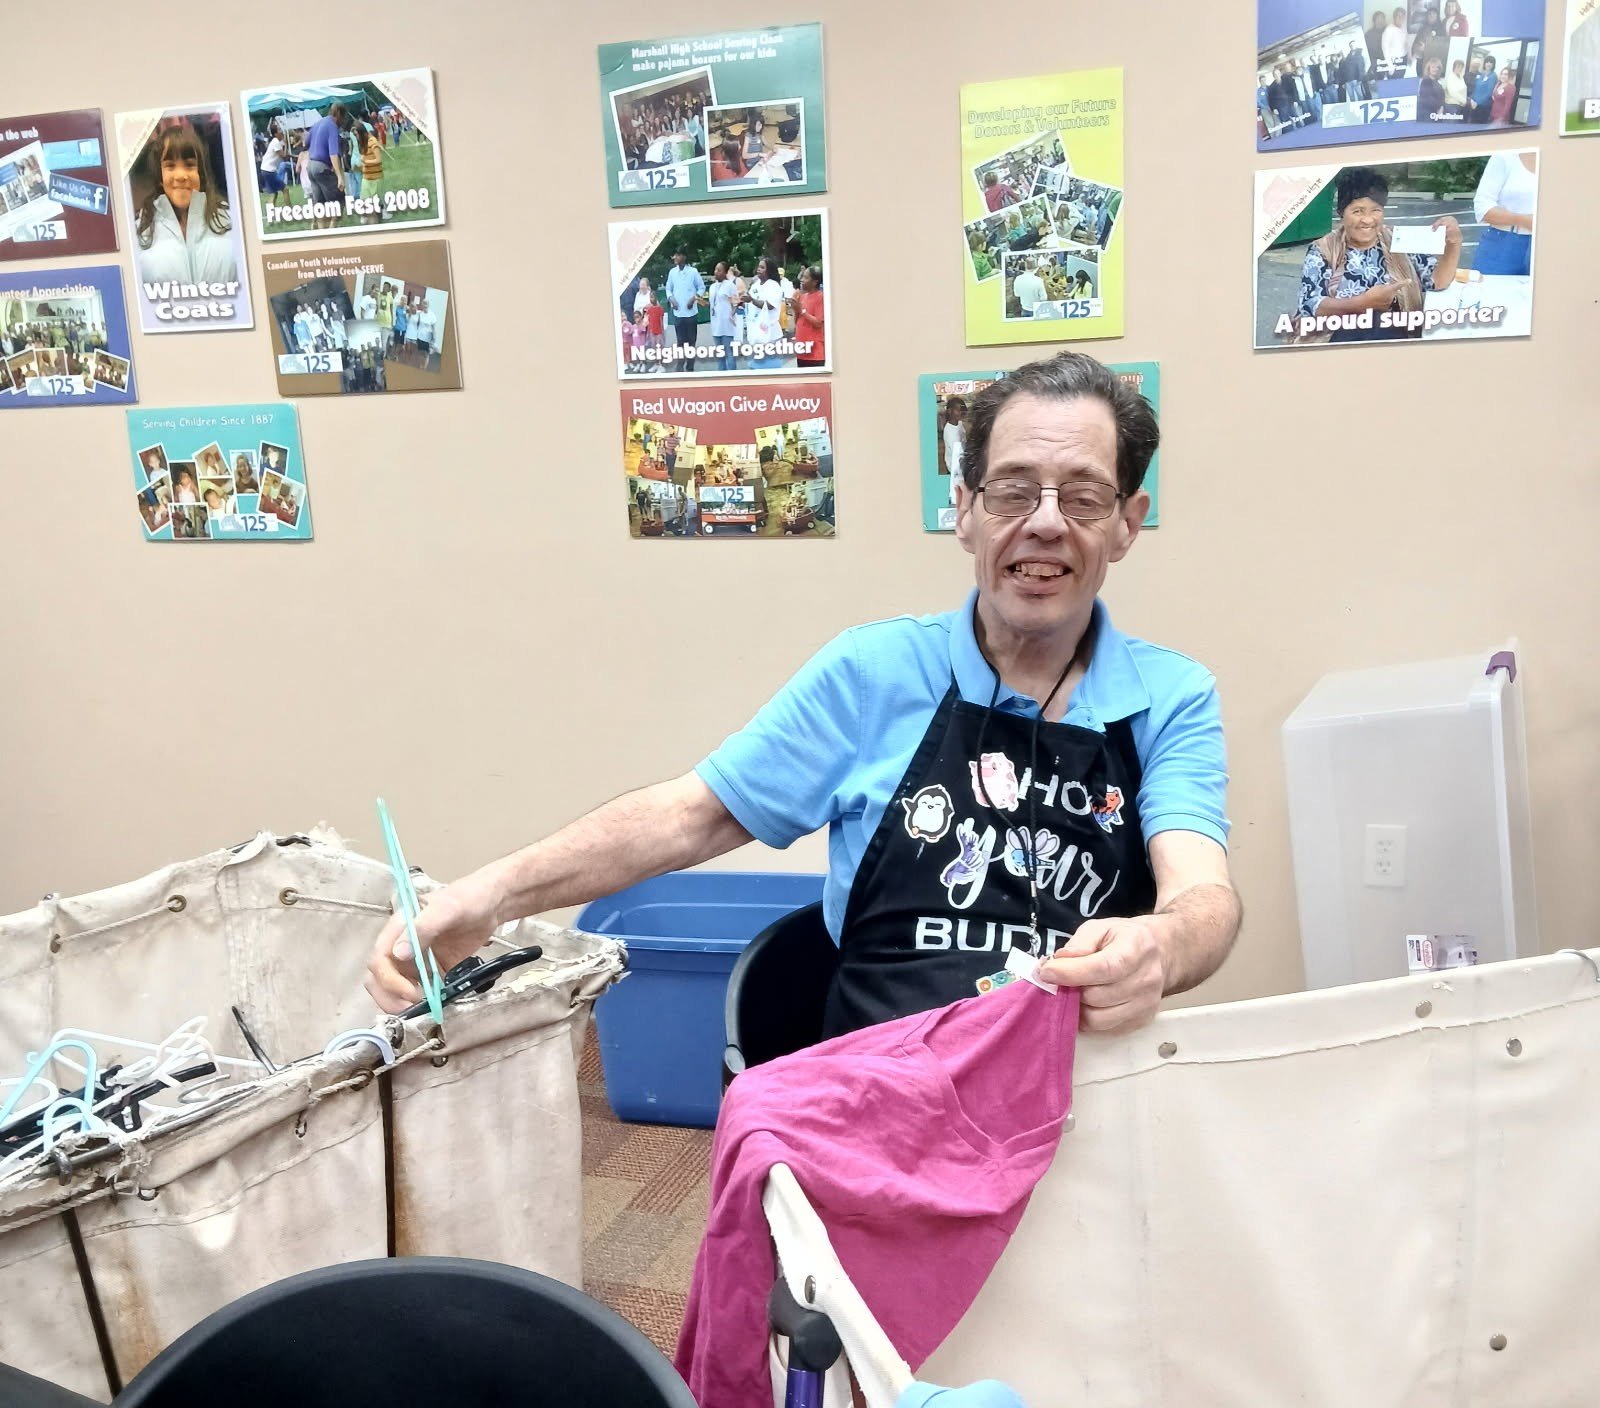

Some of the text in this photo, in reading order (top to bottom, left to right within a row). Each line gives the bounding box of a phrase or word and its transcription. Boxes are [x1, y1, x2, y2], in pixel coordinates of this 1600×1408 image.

[631, 44, 668, 59] Marshall
[670, 42, 690, 56] High
[692, 39, 722, 52] School
[632, 60, 655, 72] make
[692, 53, 721, 65] boxers
[724, 52, 737, 63] for
[740, 51, 755, 61] our
[757, 47, 776, 59] kids
[968, 98, 1116, 124] Developing our Future
[1359, 100, 1400, 124] 125
[1584, 98, 1600, 119] B
[5, 129, 20, 141] the
[20, 126, 39, 139] web
[975, 114, 1110, 138] Donors & Volunteers
[52, 178, 91, 195] Like Us On
[646, 168, 677, 190] 125
[265, 187, 430, 223] Freedom Fest 2008
[33, 223, 57, 241] 125
[266, 255, 362, 270] Canadian Youth Volunteers
[297, 263, 385, 279] from Battle Creek SERVE
[32, 283, 96, 298] Appreciation
[143, 280, 240, 301] Winter
[154, 301, 235, 321] Coats
[1060, 300, 1091, 319] 125
[1274, 304, 1504, 337] A proud supporter
[631, 337, 814, 364] Neighbors Together
[303, 353, 331, 373] 125
[48, 378, 75, 395] 125
[632, 394, 821, 416] Red Wagon Give Away
[142, 413, 274, 430] Serving Children Since 1887
[720, 488, 745, 504] 125
[240, 515, 268, 532] 125
